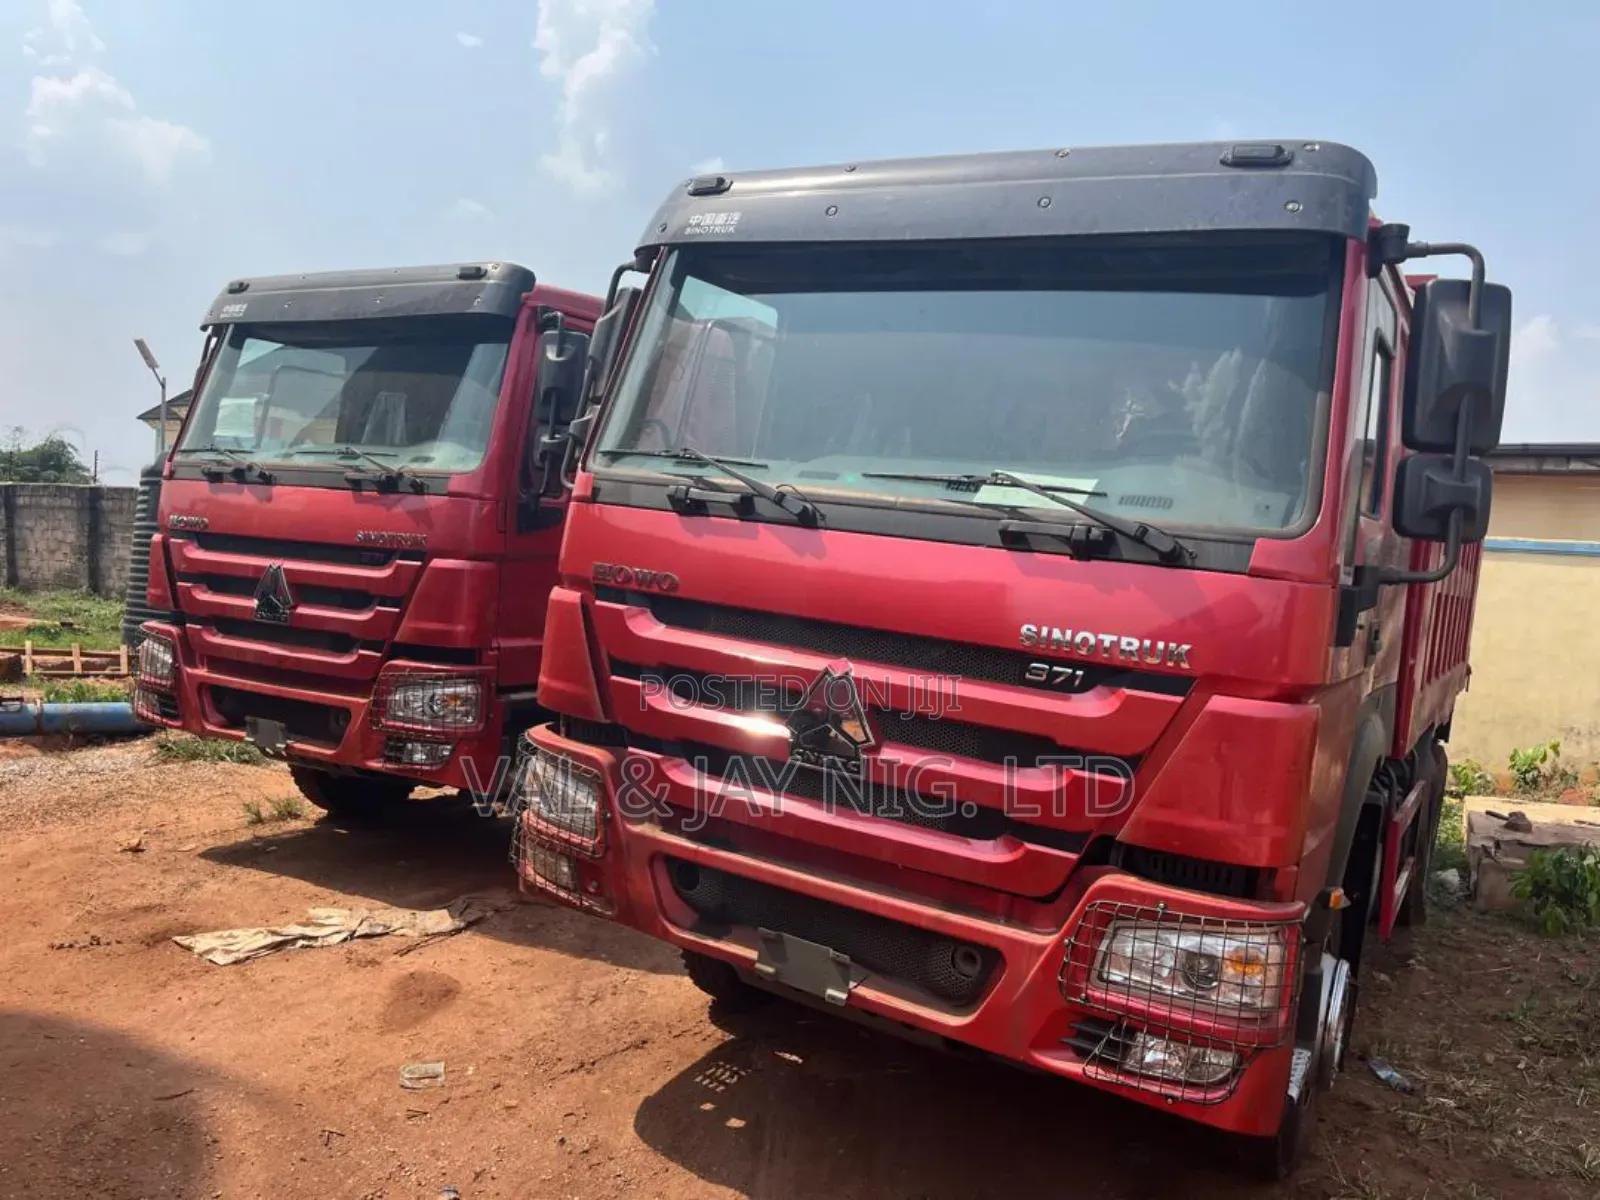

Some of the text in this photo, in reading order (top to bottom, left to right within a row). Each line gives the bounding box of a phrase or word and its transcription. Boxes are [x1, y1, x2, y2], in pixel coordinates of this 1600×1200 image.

[684, 225, 736, 235] SINOTRUK
[1019, 623, 1192, 669] SINOTRUK
[1024, 662, 1085, 687] 371
